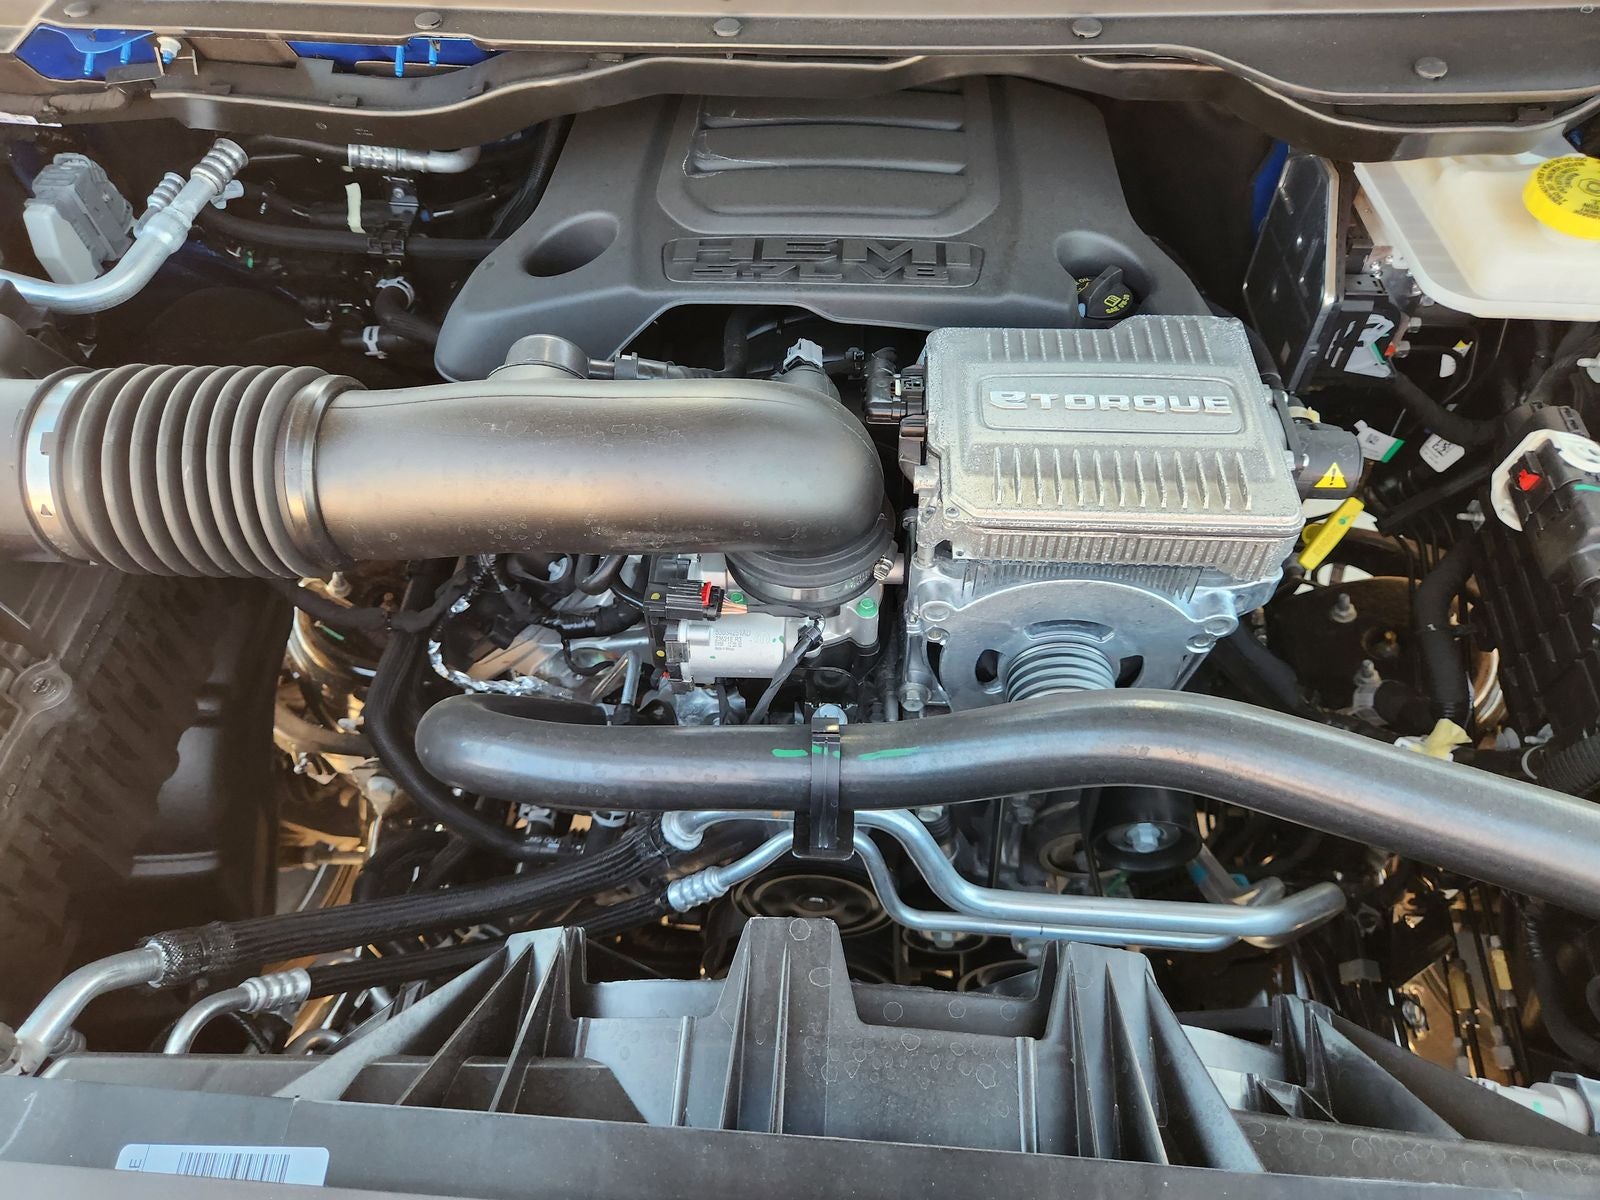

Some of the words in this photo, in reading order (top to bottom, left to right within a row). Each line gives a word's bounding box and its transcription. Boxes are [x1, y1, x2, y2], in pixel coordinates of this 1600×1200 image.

[672, 238, 971, 266] HEMI
[692, 262, 843, 279] 5.7L
[857, 263, 949, 281] V8
[989, 391, 1233, 415] eTORQUE
